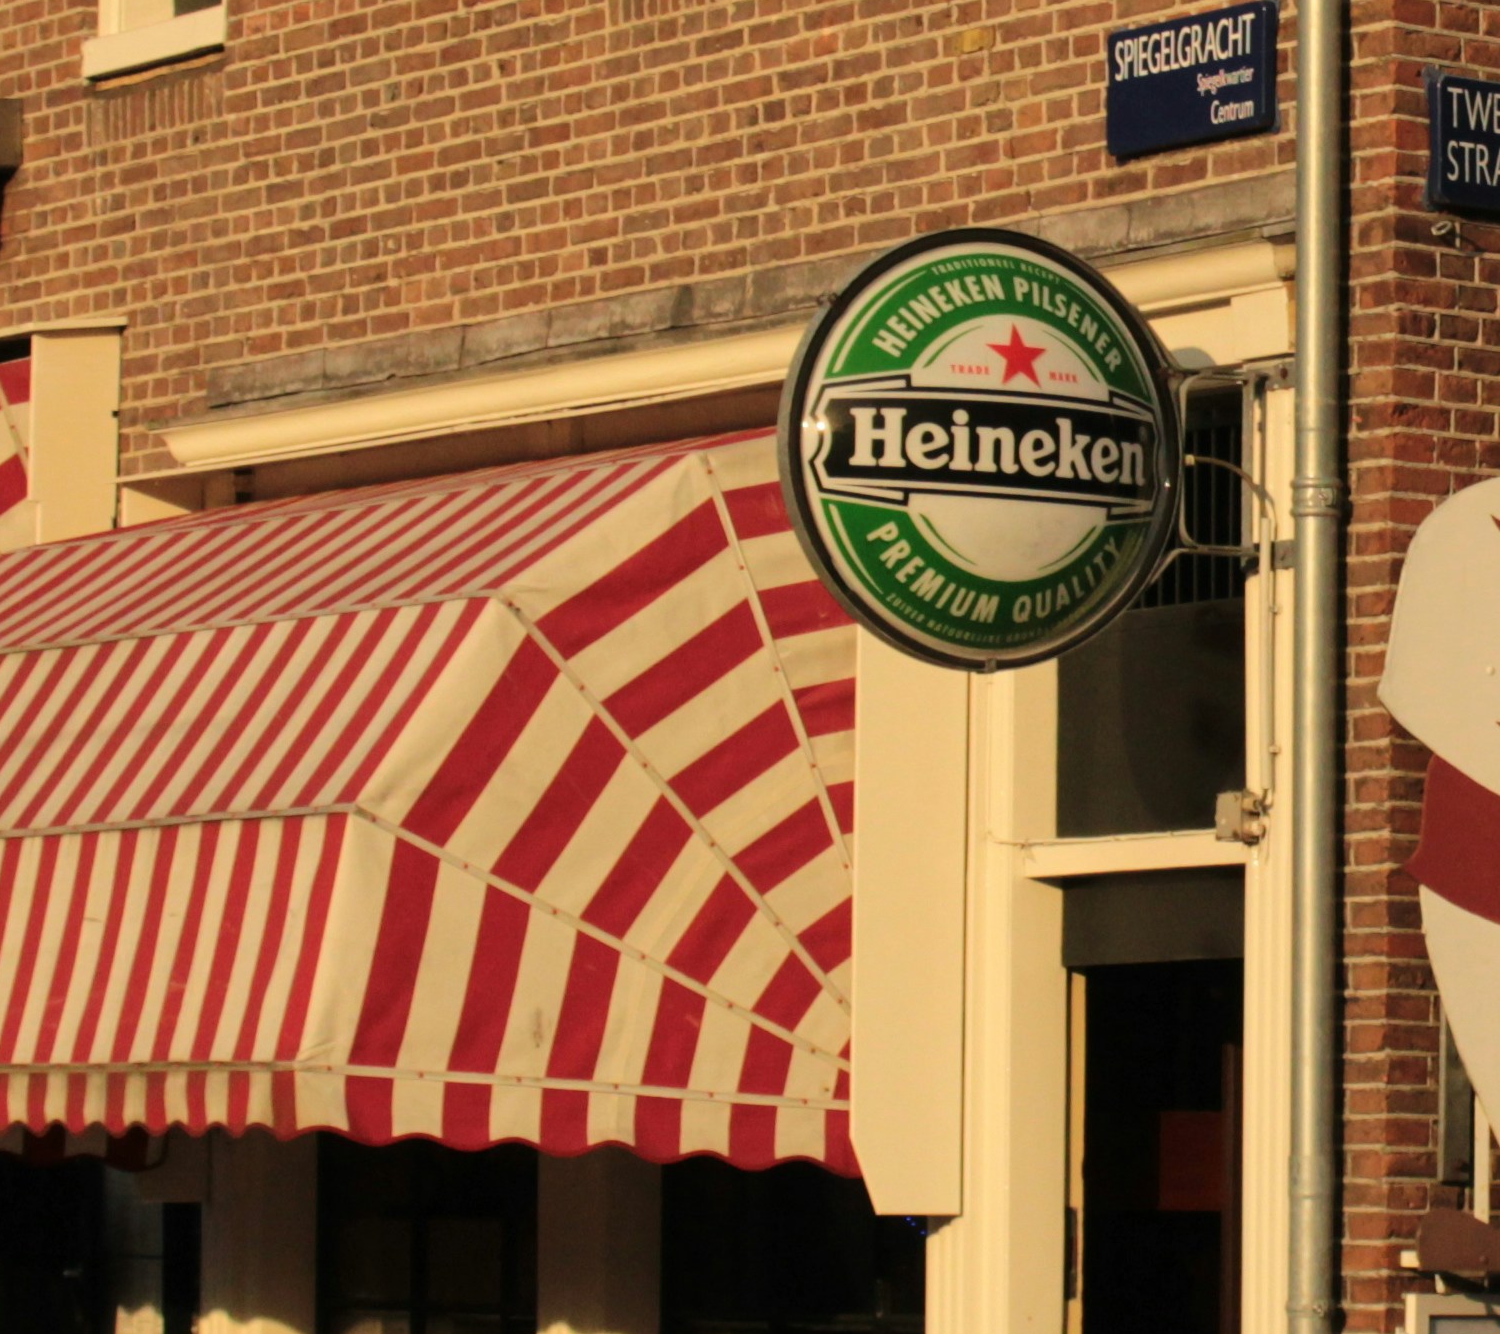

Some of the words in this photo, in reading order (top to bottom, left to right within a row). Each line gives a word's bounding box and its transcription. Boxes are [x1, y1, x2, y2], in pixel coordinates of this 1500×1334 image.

[1114, 13, 1256, 82] SPIEGELGRACHT
[1197, 67, 1255, 97] Spiegelkwartier
[1211, 100, 1254, 124] Centrum
[872, 274, 1005, 358] HEINEKEN
[1012, 275, 1123, 373] PILSENER
[949, 363, 991, 376] TRADE
[1048, 370, 1079, 384] MARK
[848, 407, 1147, 487] Heineken
[866, 521, 1000, 624] PREMIUM
[1012, 535, 1121, 624] QUALITY
